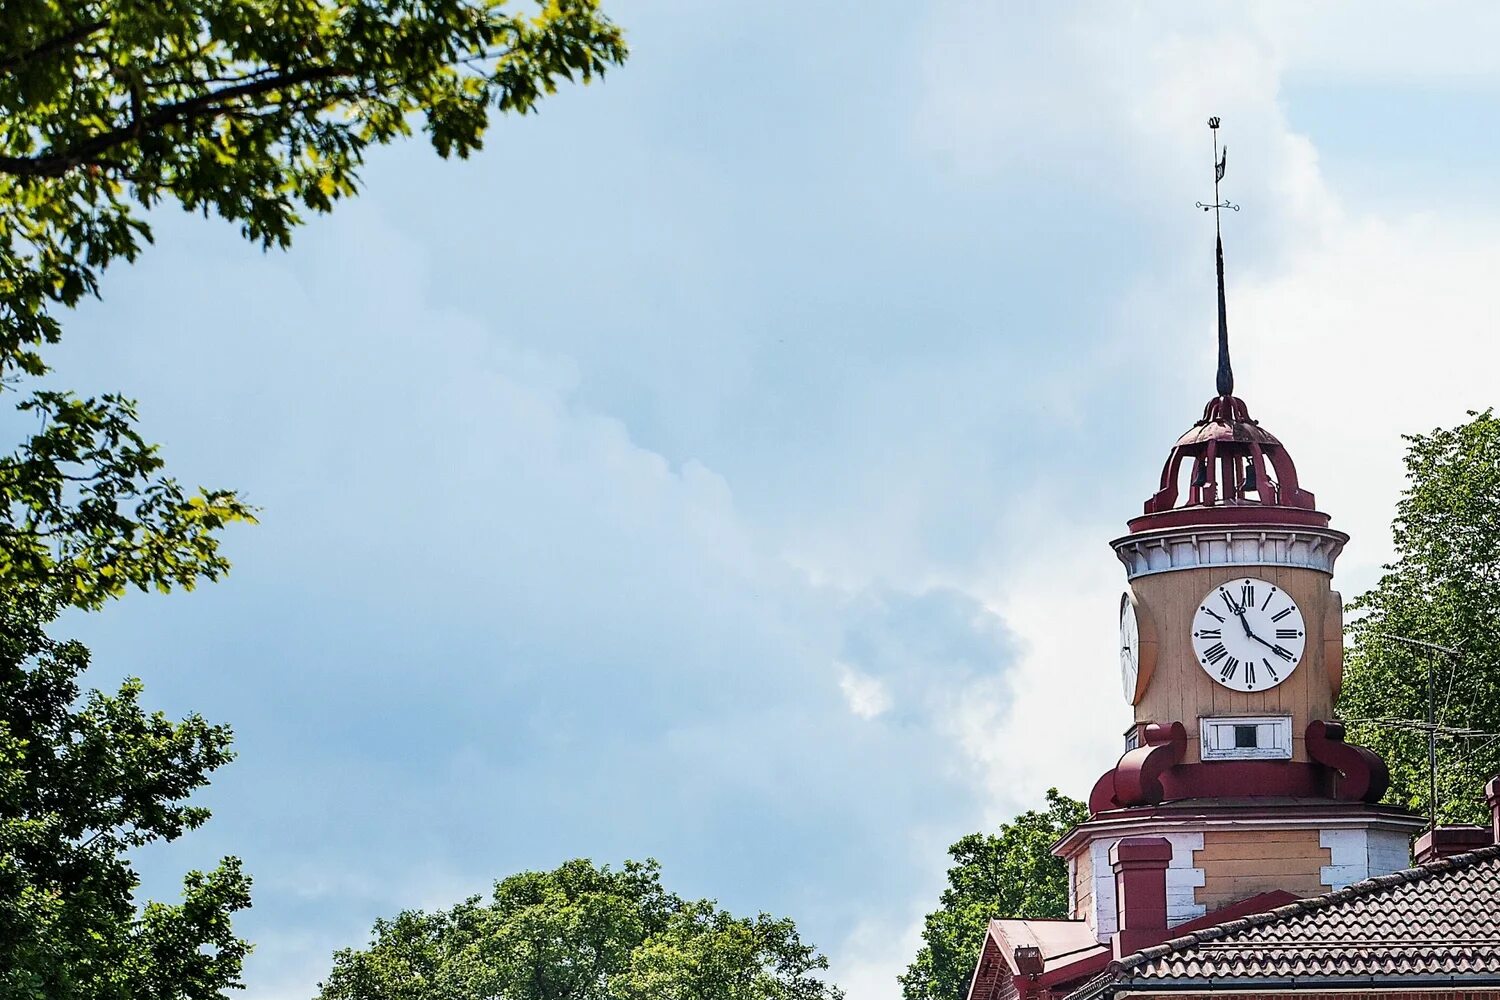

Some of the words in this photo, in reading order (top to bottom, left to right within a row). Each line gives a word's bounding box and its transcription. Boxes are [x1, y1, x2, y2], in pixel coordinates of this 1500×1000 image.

[1241, 586, 1254, 607] XII
[1205, 608, 1226, 623] X
[1271, 608, 1292, 623] II
[1200, 629, 1221, 639] IX
[1276, 629, 1297, 639] III
[1203, 642, 1228, 666] VIII
[1220, 656, 1239, 680] VII
[1245, 662, 1256, 684] VI
[1263, 658, 1277, 678] V
